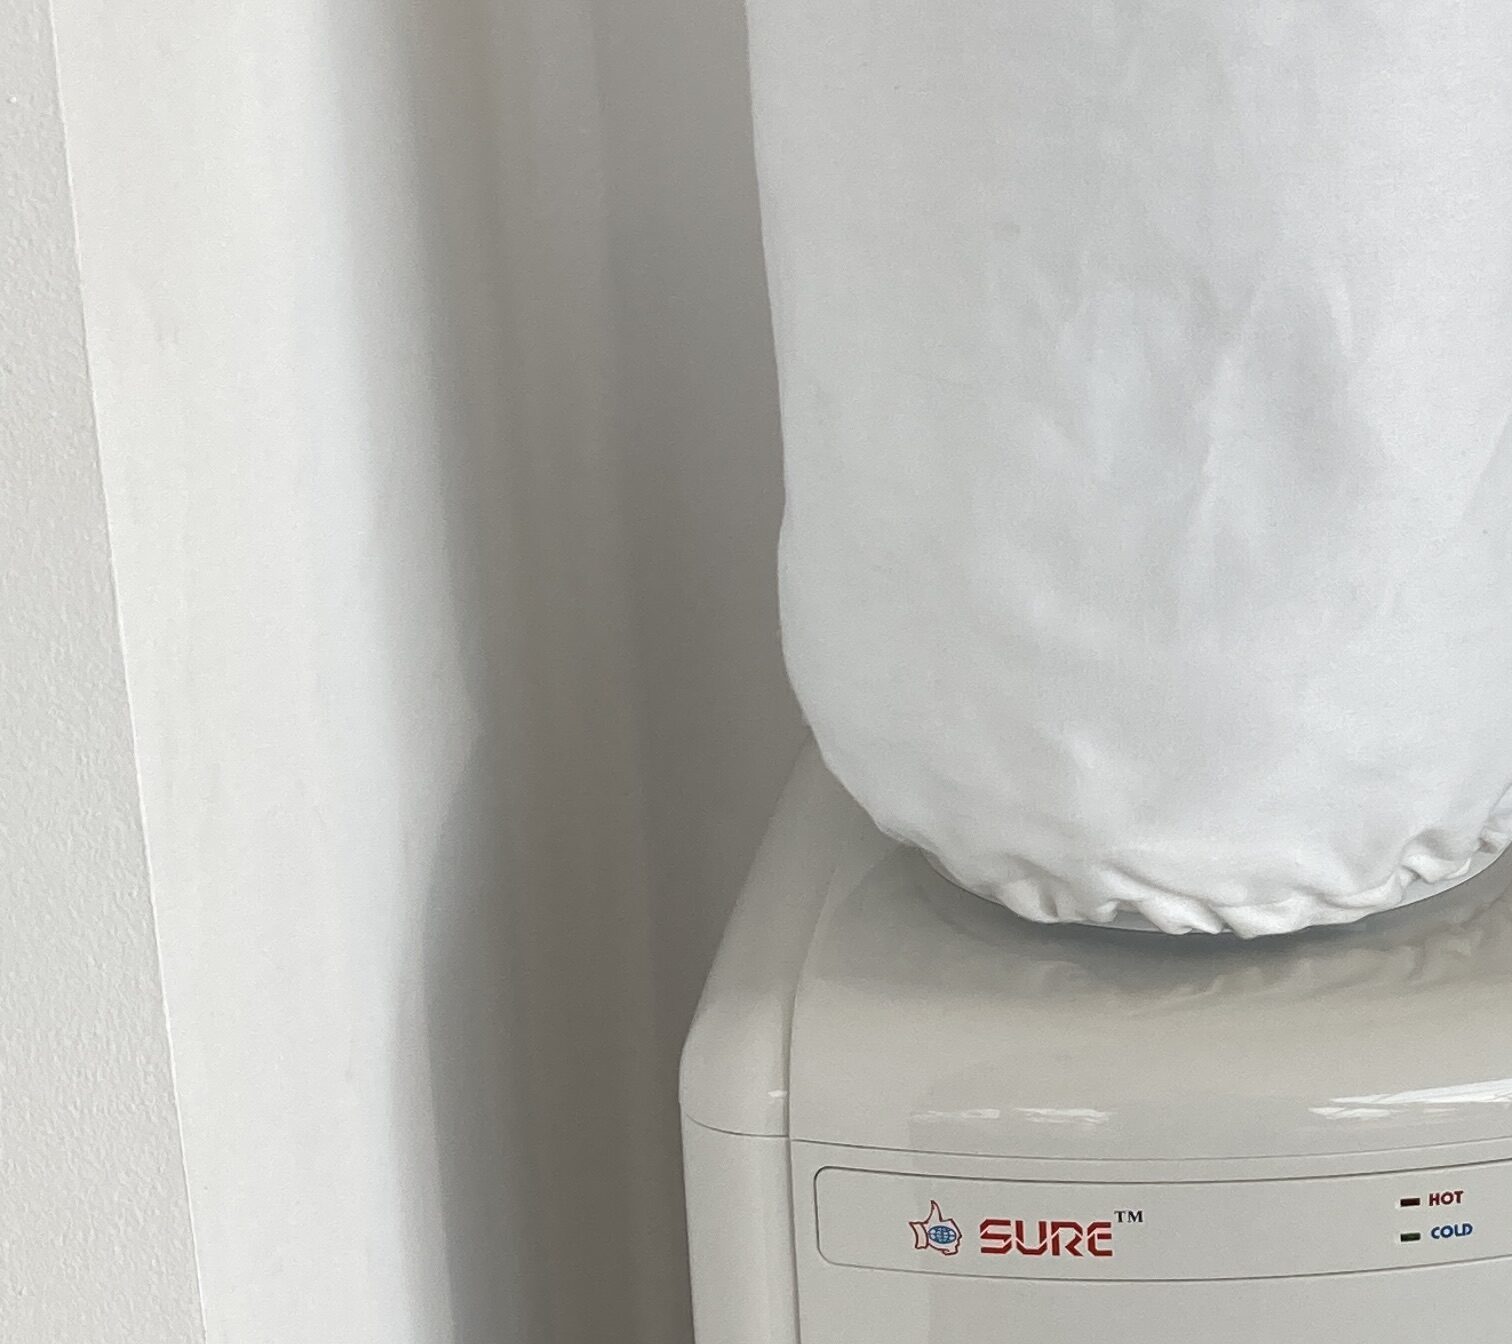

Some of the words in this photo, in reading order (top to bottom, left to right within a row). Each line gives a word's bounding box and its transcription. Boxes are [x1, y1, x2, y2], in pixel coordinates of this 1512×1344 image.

[1429, 1190, 1464, 1206] HOT
[979, 1218, 1113, 1257] SURE
[1114, 1210, 1144, 1223] TM
[1431, 1223, 1473, 1239] COLD
